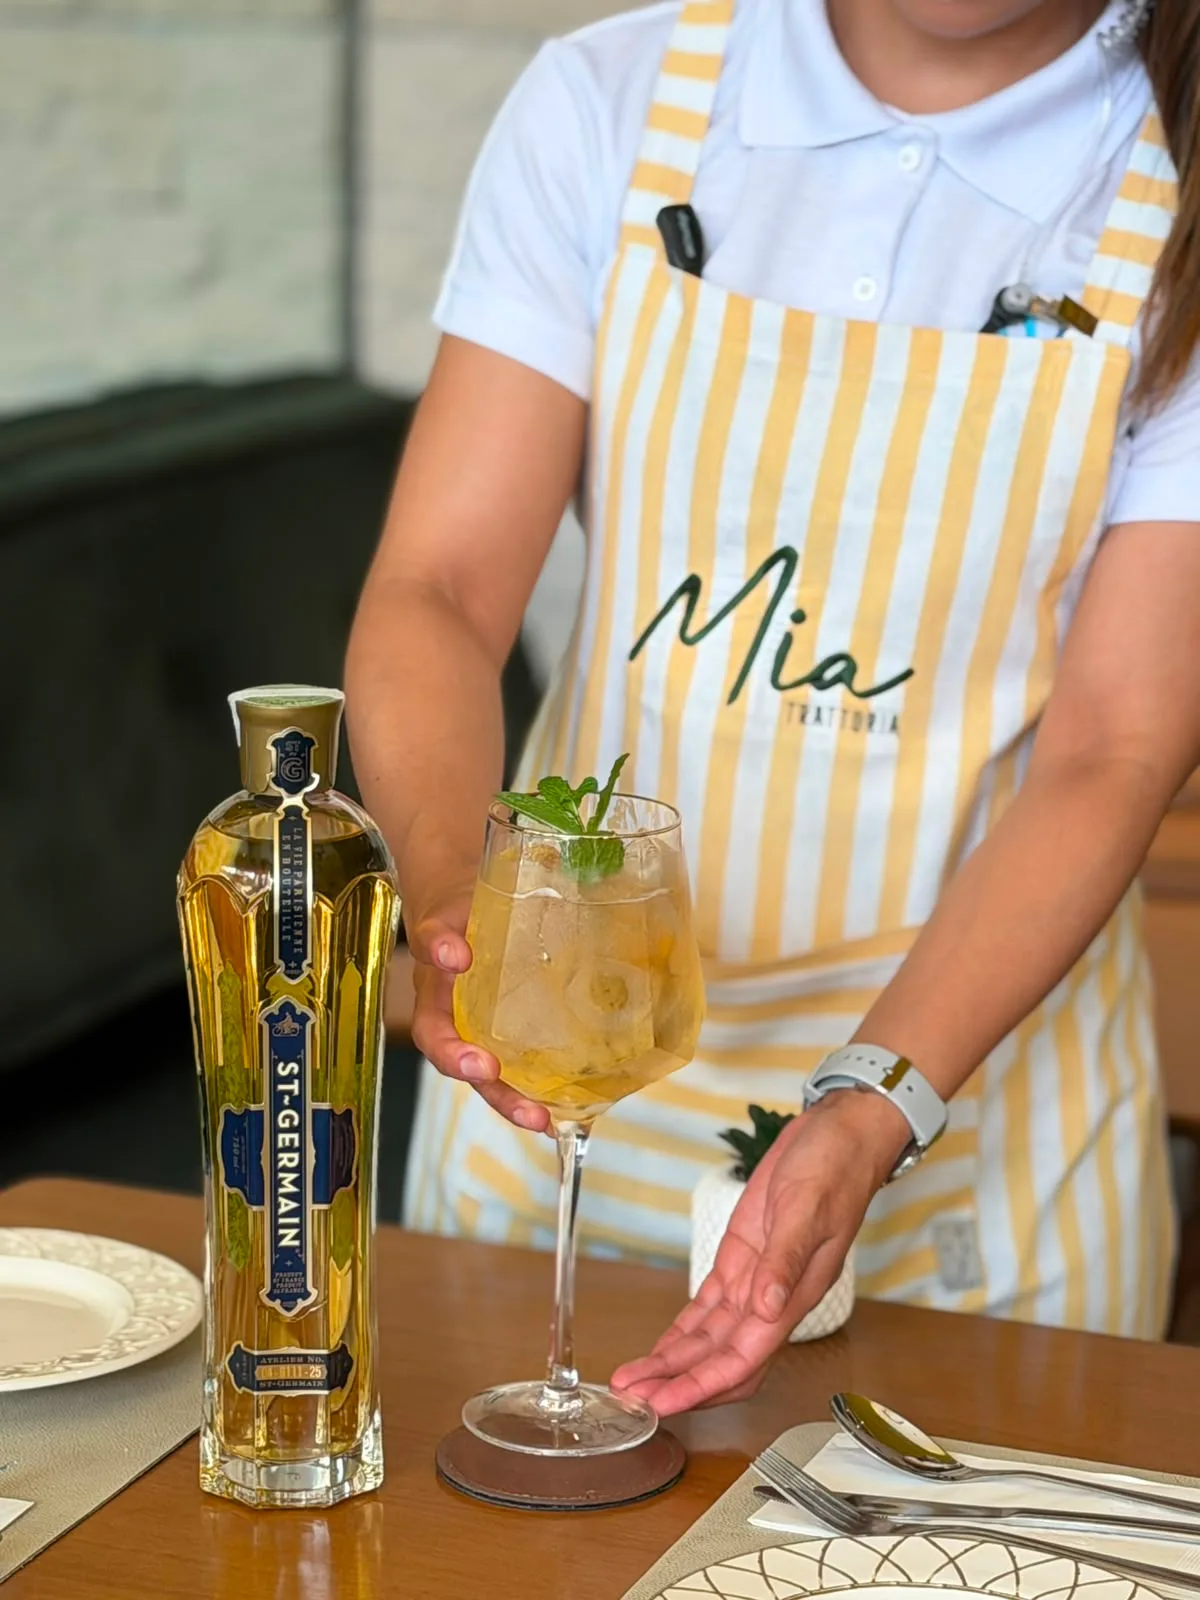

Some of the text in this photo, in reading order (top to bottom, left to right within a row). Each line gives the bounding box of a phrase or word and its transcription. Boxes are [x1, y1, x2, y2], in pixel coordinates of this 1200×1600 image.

[628, 545, 915, 705] Mia
[786, 702, 899, 734] TRATTORIA
[282, 834, 292, 942] EN BOUTEILLE
[293, 827, 304, 953] LA VIE PARISIENNE
